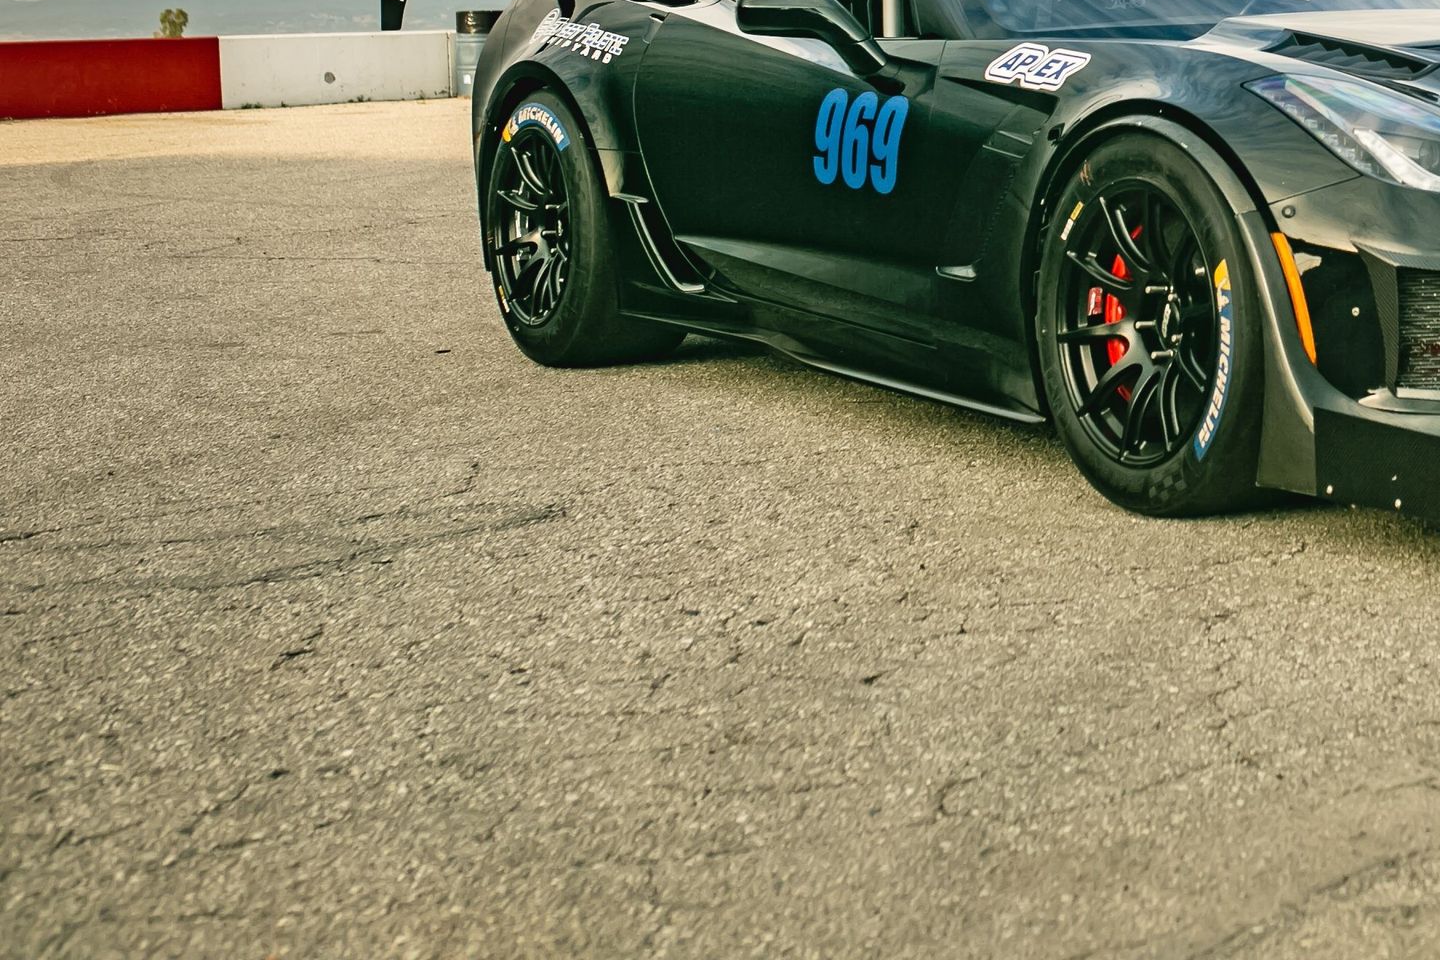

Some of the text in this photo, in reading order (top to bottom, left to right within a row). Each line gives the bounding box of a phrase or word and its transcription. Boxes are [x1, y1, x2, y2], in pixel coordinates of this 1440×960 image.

[518, 106, 564, 144] MICHELIN
[813, 87, 909, 194] 969
[1198, 316, 1230, 448] MICHELIN
